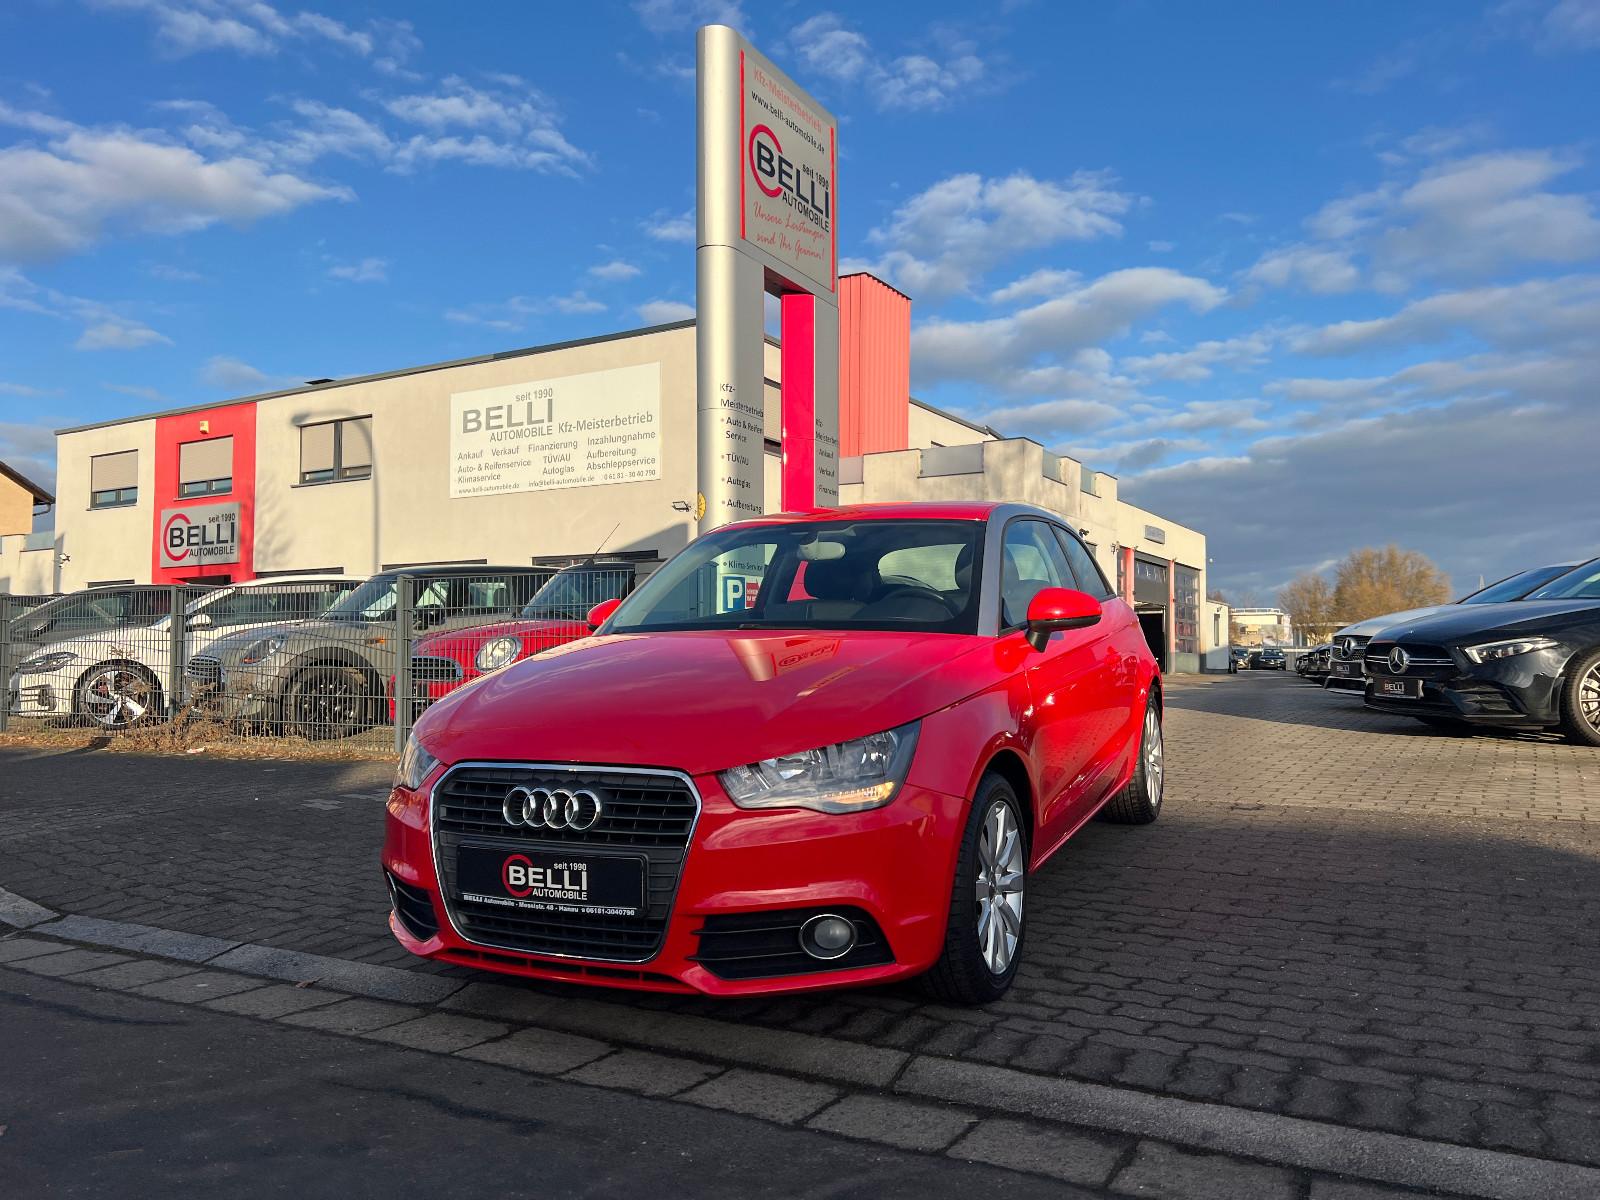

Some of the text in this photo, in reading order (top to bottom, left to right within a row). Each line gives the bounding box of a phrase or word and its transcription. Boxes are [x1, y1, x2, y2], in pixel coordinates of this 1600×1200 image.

[754, 66, 822, 133] Kfz-Meisterbetrieb
[751, 91, 825, 154] www.belli-automobile.de
[757, 140, 829, 219] BELLI
[803, 164, 829, 190] seit 1990
[754, 202, 783, 225] Unsere
[782, 191, 829, 232] AUTOMOBILE
[757, 232, 776, 245] sind
[516, 388, 553, 401] seit 1990
[720, 383, 736, 392] Kfz-
[462, 399, 552, 434] BELLI
[721, 399, 764, 417] Meisterbetrieb
[558, 411, 653, 433] Kfz-Meisterbetrieb
[726, 417, 741, 427] Auto
[490, 425, 552, 442] AUTOMOBILE
[726, 431, 747, 442] Service
[458, 431, 656, 460] Ankauf Verkauf Finanzierung Inzahlungnahme
[458, 464, 476, 474] Auto-
[485, 459, 531, 471] Reifenservice
[543, 453, 571, 464] TÜV/AU
[587, 448, 636, 460] Aufbereitung
[458, 456, 656, 484] Klimaservice Autoglas Abschleppservice
[208, 513, 236, 523] seit 1990
[170, 522, 235, 548] BELLI
[189, 545, 235, 557] AUTOMOBILE
[727, 580, 742, 608] P
[1384, 682, 1405, 692] BELLI
[553, 862, 587, 871] seit 1990
[508, 865, 588, 891] BELLI
[463, 894, 482, 902] BELLI
[484, 897, 515, 907] Automobile
[532, 888, 588, 901] AUTOMOBILE
